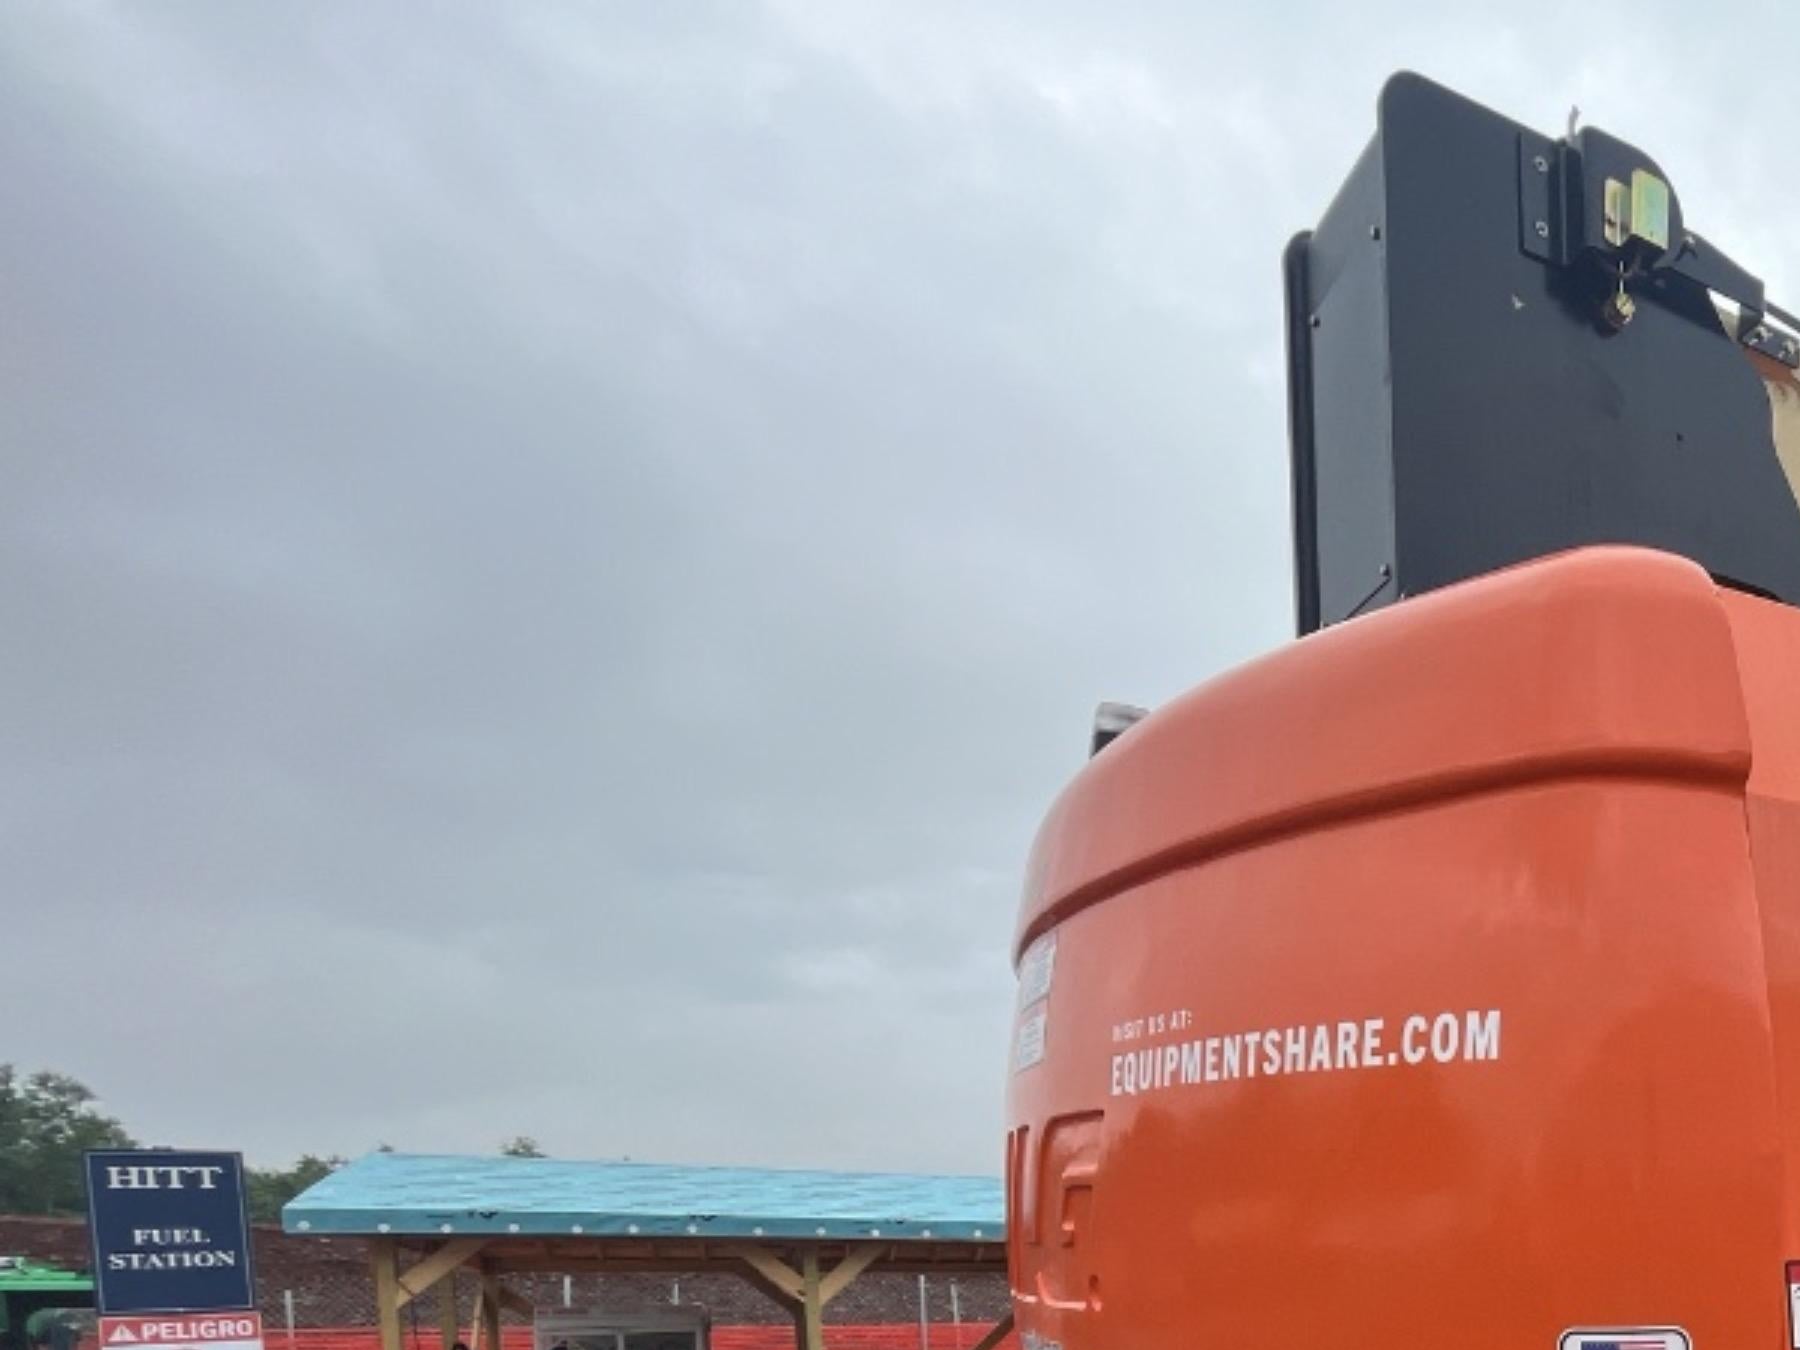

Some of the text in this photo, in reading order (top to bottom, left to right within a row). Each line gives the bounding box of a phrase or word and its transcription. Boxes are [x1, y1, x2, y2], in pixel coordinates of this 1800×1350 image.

[1111, 1010, 1500, 1096] EQUIPMENTSHARE.COM
[106, 1166, 223, 1189] HITT
[133, 1228, 211, 1245] FUEL
[108, 1251, 235, 1270] STATION
[141, 1319, 253, 1341] PELIGRO
